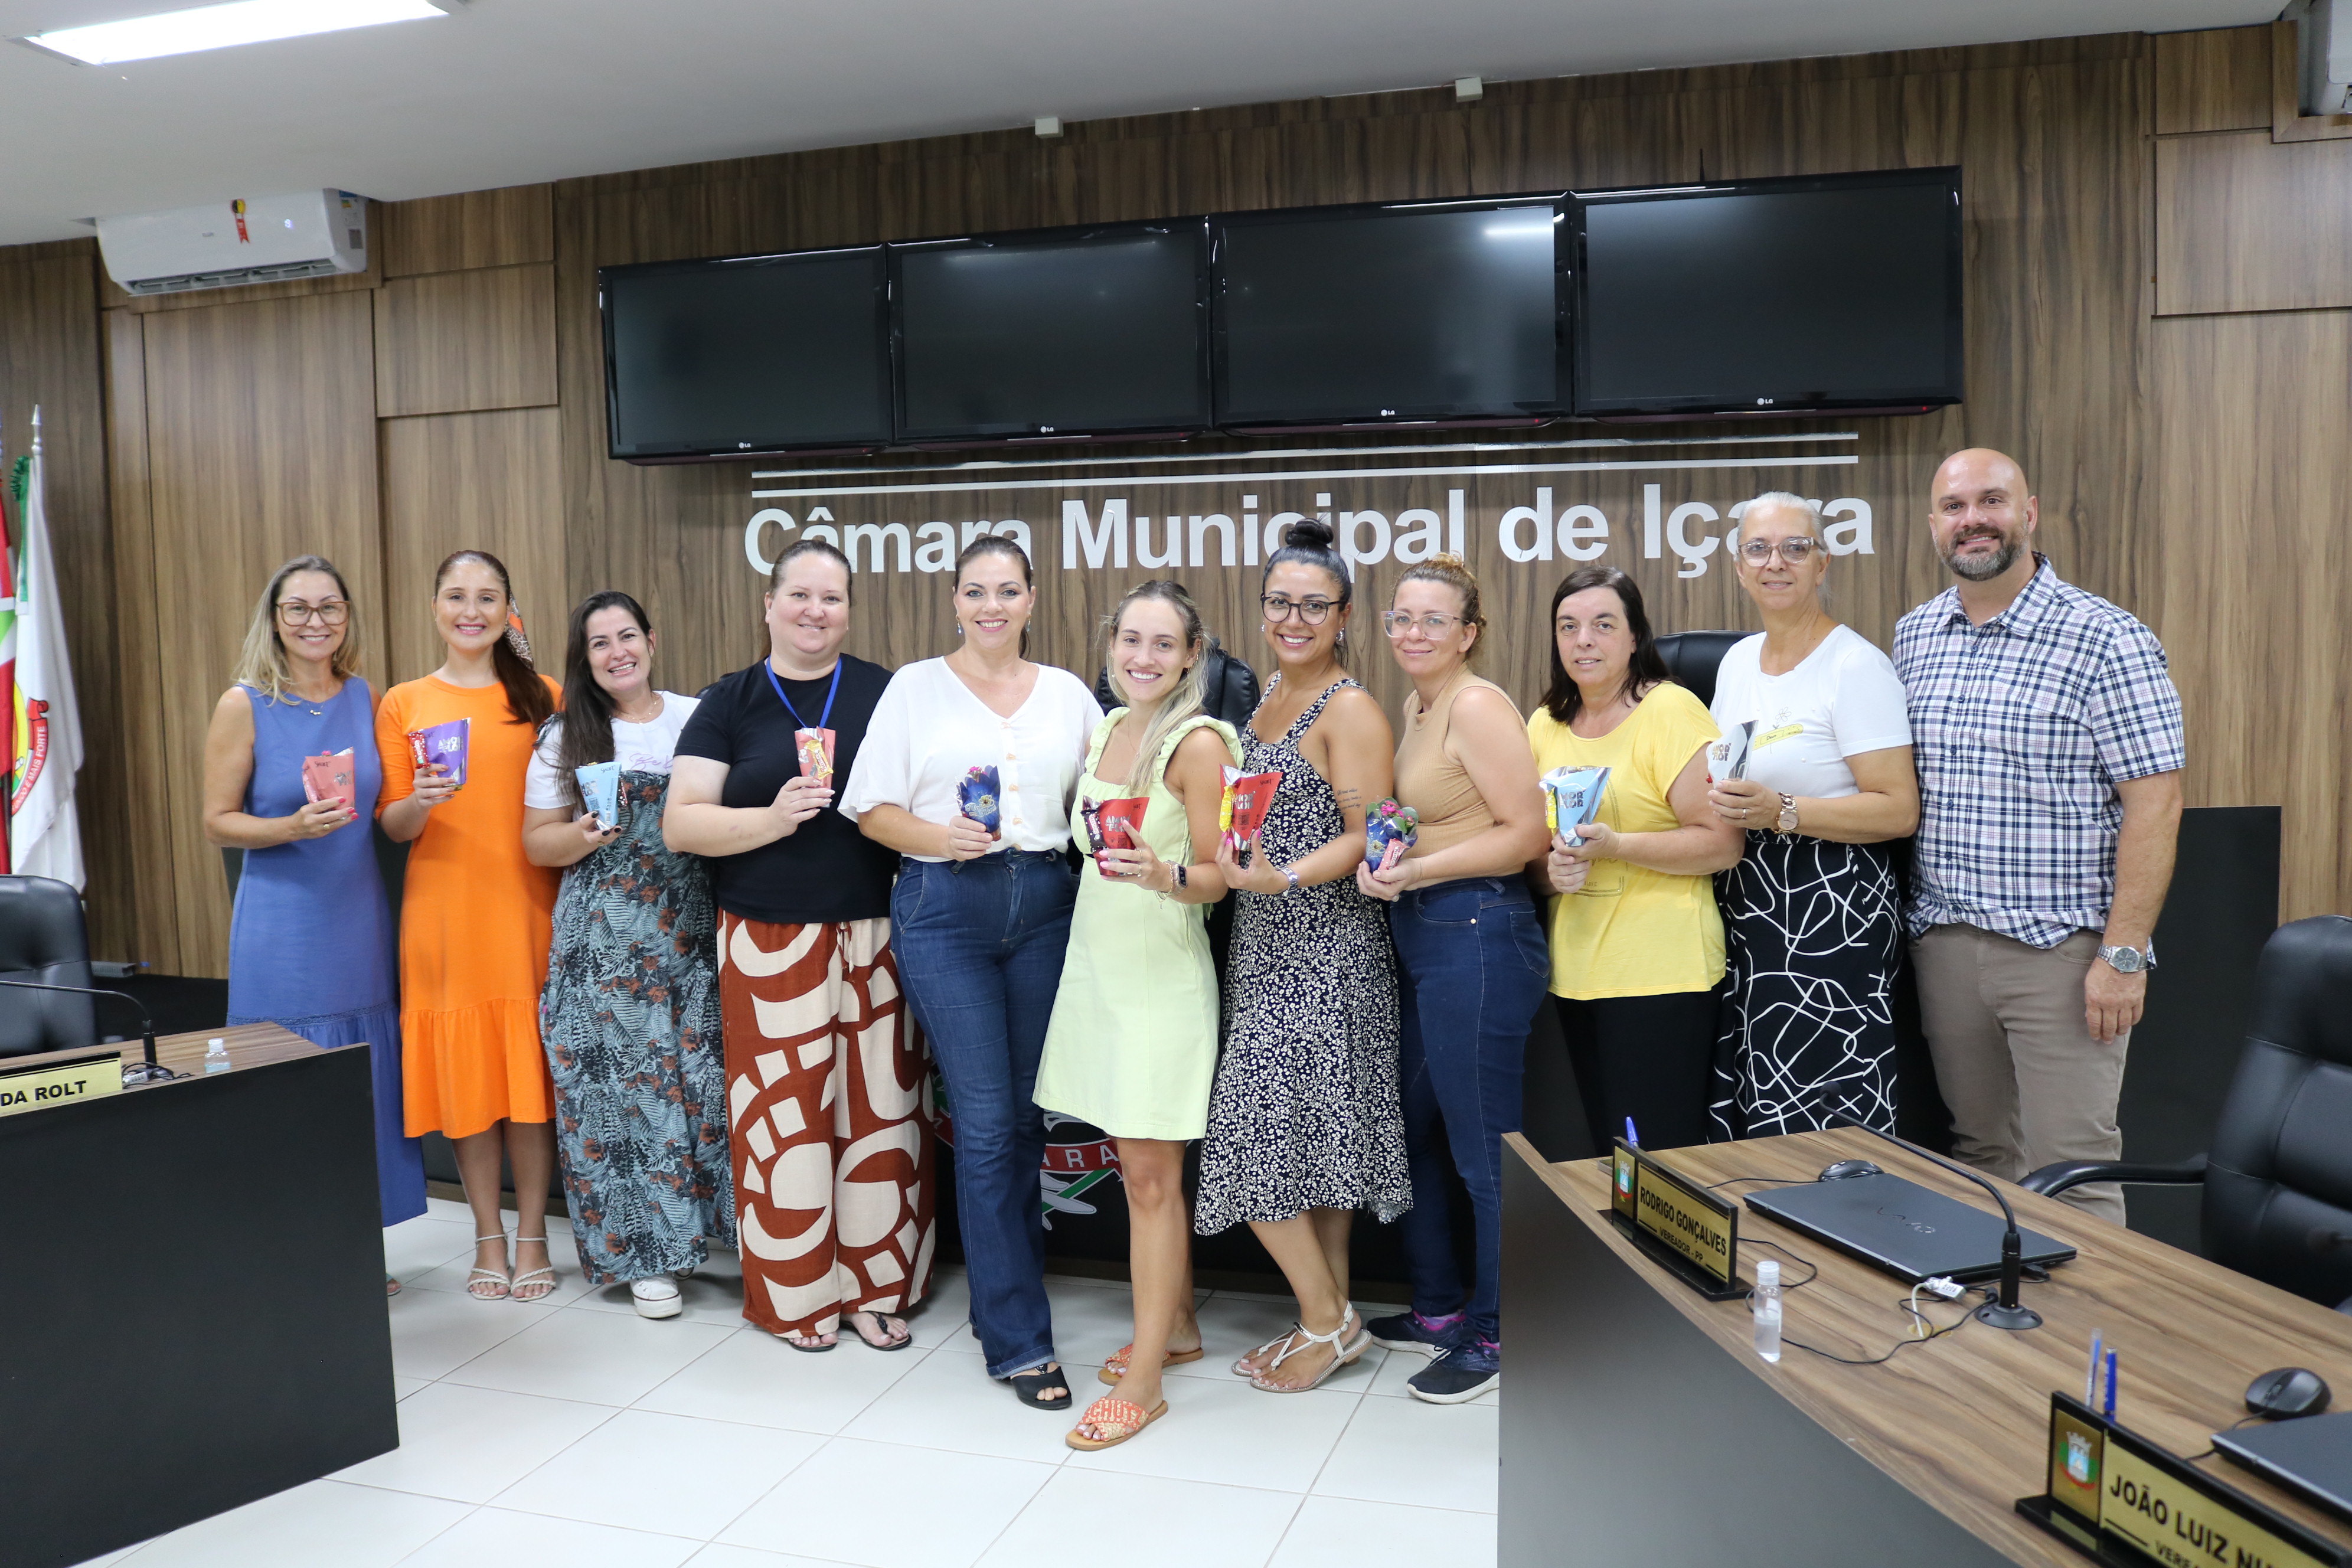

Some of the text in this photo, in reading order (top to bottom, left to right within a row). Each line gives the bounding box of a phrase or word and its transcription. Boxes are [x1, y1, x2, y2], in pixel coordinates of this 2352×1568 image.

[1498, 486, 1609, 562] de
[1644, 484, 1875, 579] Iça
[28, 759, 41, 782] MAIS
[36, 725, 45, 757] FORTE
[0, 1080, 87, 1106] DA ROLT
[1641, 1186, 1726, 1256] RODRIGO GONÇALVES
[1660, 1226, 1690, 1256] VEREADOR
[1695, 1250, 1704, 1262] PP
[2110, 1475, 2168, 1525] JOÃO
[2175, 1510, 2229, 1564] LUIZ
